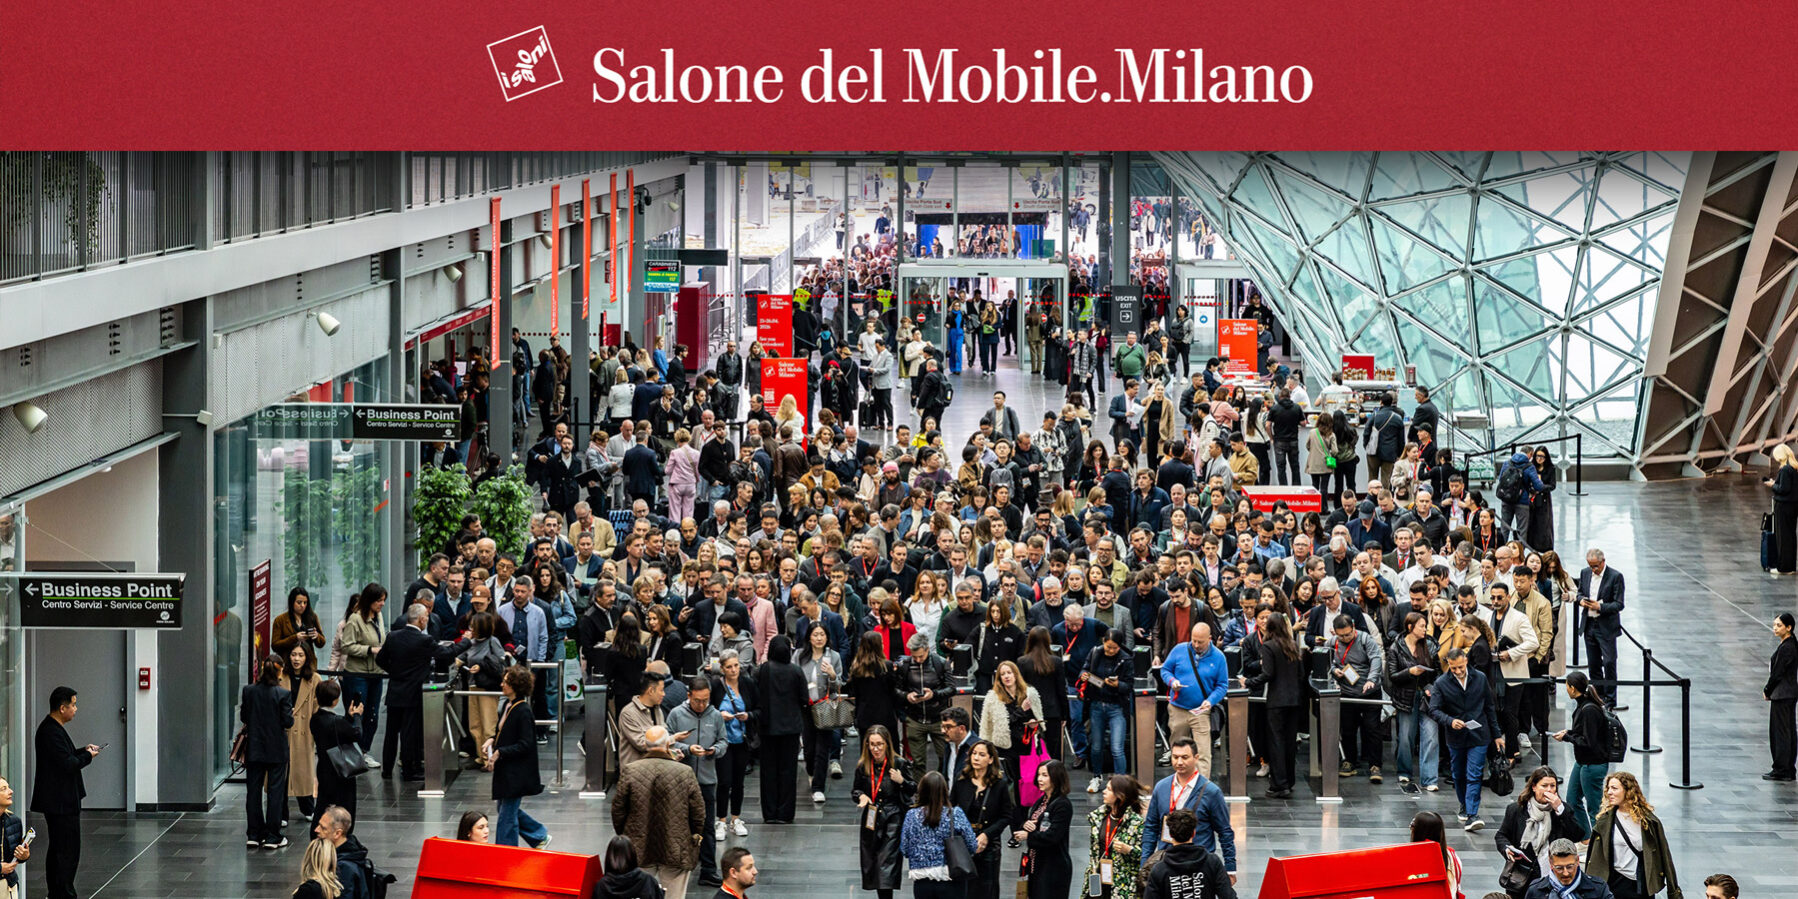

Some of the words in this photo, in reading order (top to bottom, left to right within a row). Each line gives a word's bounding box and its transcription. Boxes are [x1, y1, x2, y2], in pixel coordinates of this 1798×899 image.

[367, 409, 421, 420] Business
[424, 410, 455, 420] Point
[412, 421, 434, 429] Service
[41, 582, 122, 598] Business
[127, 583, 173, 598] Point
[42, 600, 72, 609] Centro
[74, 600, 103, 609] Servizi
[110, 601, 142, 610] Service
[144, 601, 175, 610] Centre
[1181, 874, 1193, 891] del
